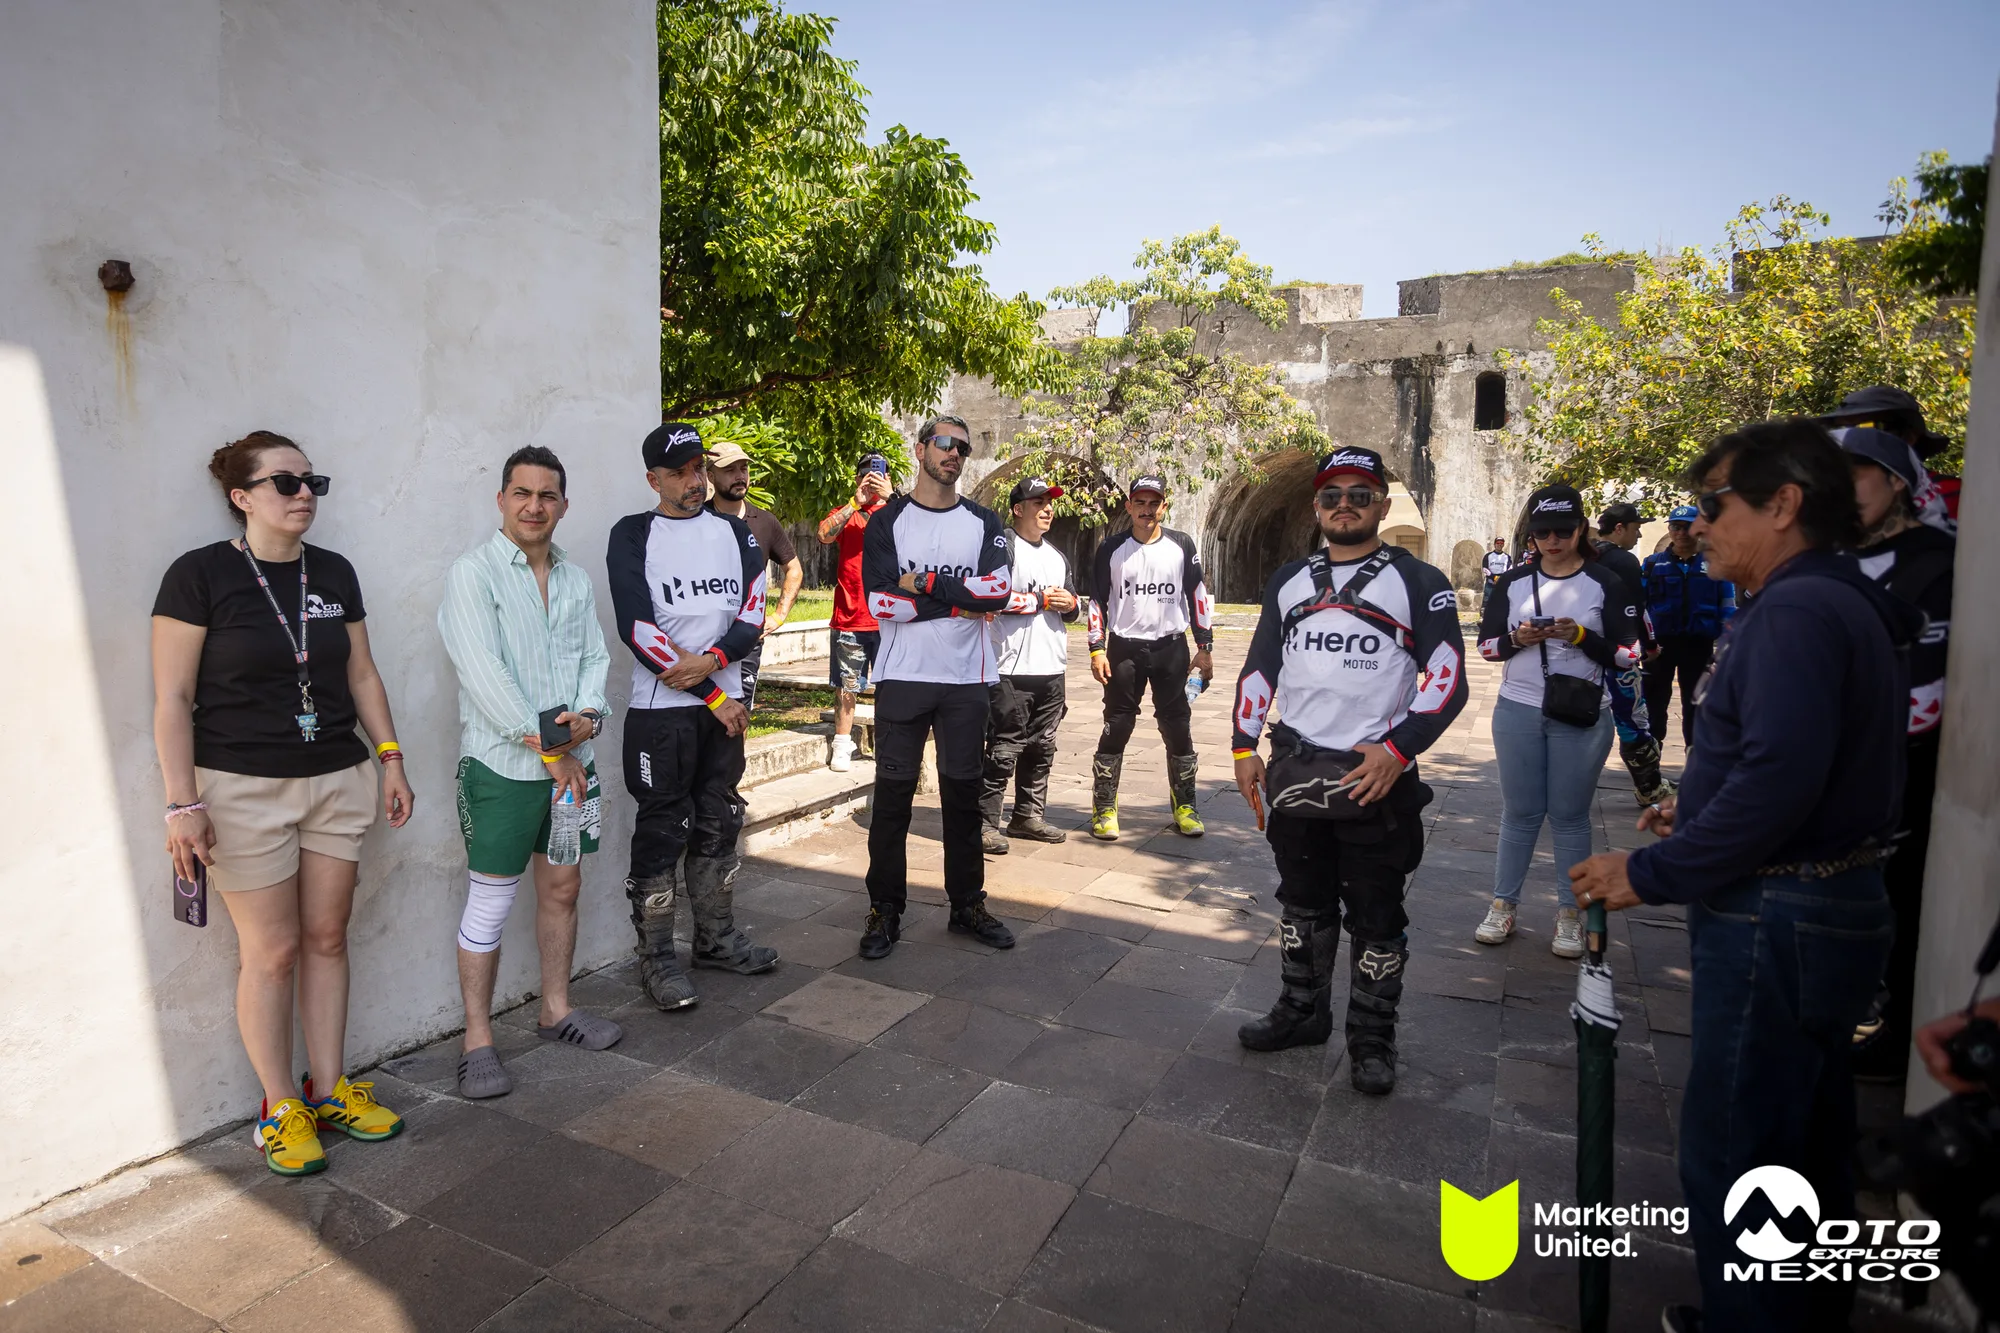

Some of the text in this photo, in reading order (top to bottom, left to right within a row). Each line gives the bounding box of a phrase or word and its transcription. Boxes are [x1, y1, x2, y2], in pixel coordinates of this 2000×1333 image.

[691, 578, 740, 597] Hero
[1135, 583, 1176, 596] Hero
[1304, 631, 1380, 655] Hero
[1343, 658, 1379, 670] MOTOS
